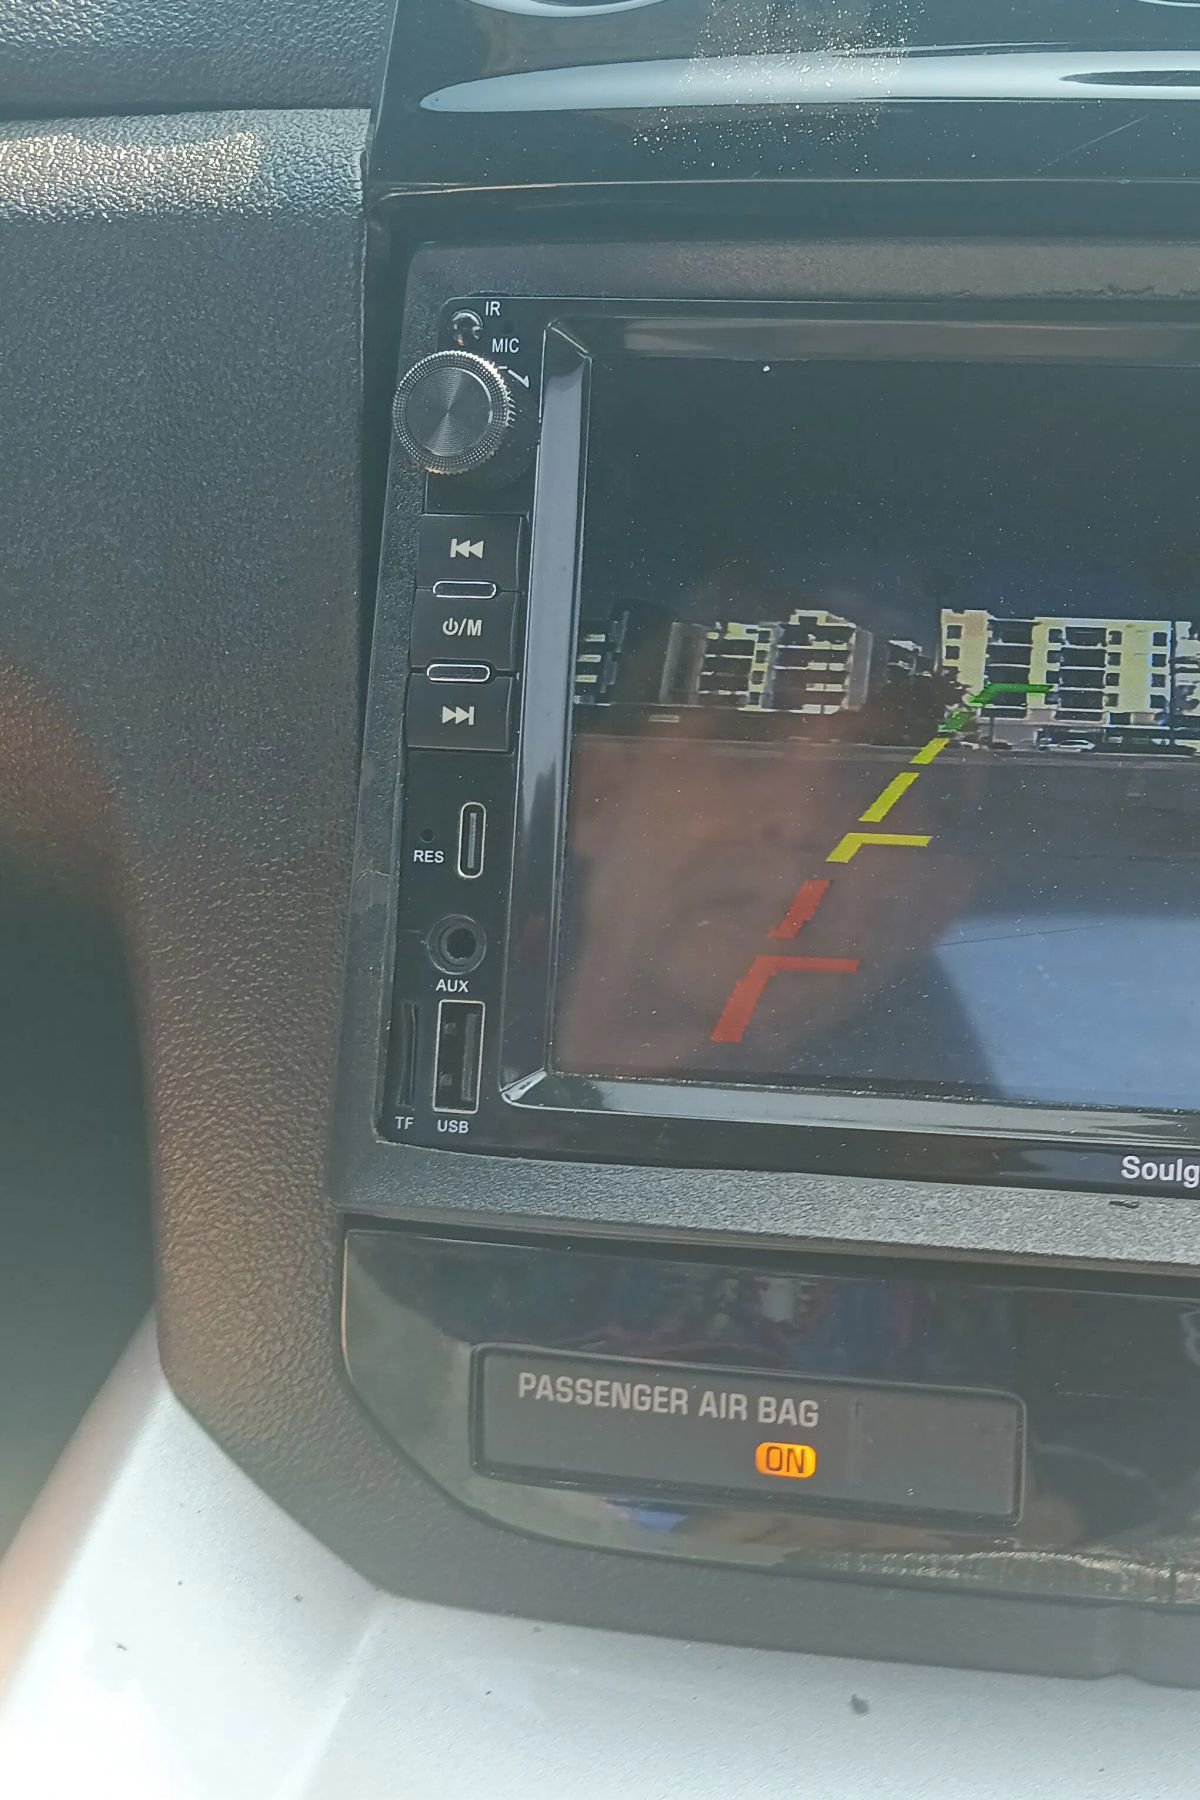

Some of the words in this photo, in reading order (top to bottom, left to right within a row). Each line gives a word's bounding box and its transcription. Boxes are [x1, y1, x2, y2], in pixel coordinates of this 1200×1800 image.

[485, 301, 501, 316] IR
[492, 338, 520, 354] MIC
[413, 849, 445, 864] RES
[435, 979, 469, 993] AUX
[395, 1116, 415, 1130] TF
[437, 1119, 469, 1134] USB
[518, 1371, 689, 1416] PASSENGER
[698, 1390, 749, 1422] AIR
[757, 1396, 820, 1428] BAG
[763, 1445, 807, 1475] ON
